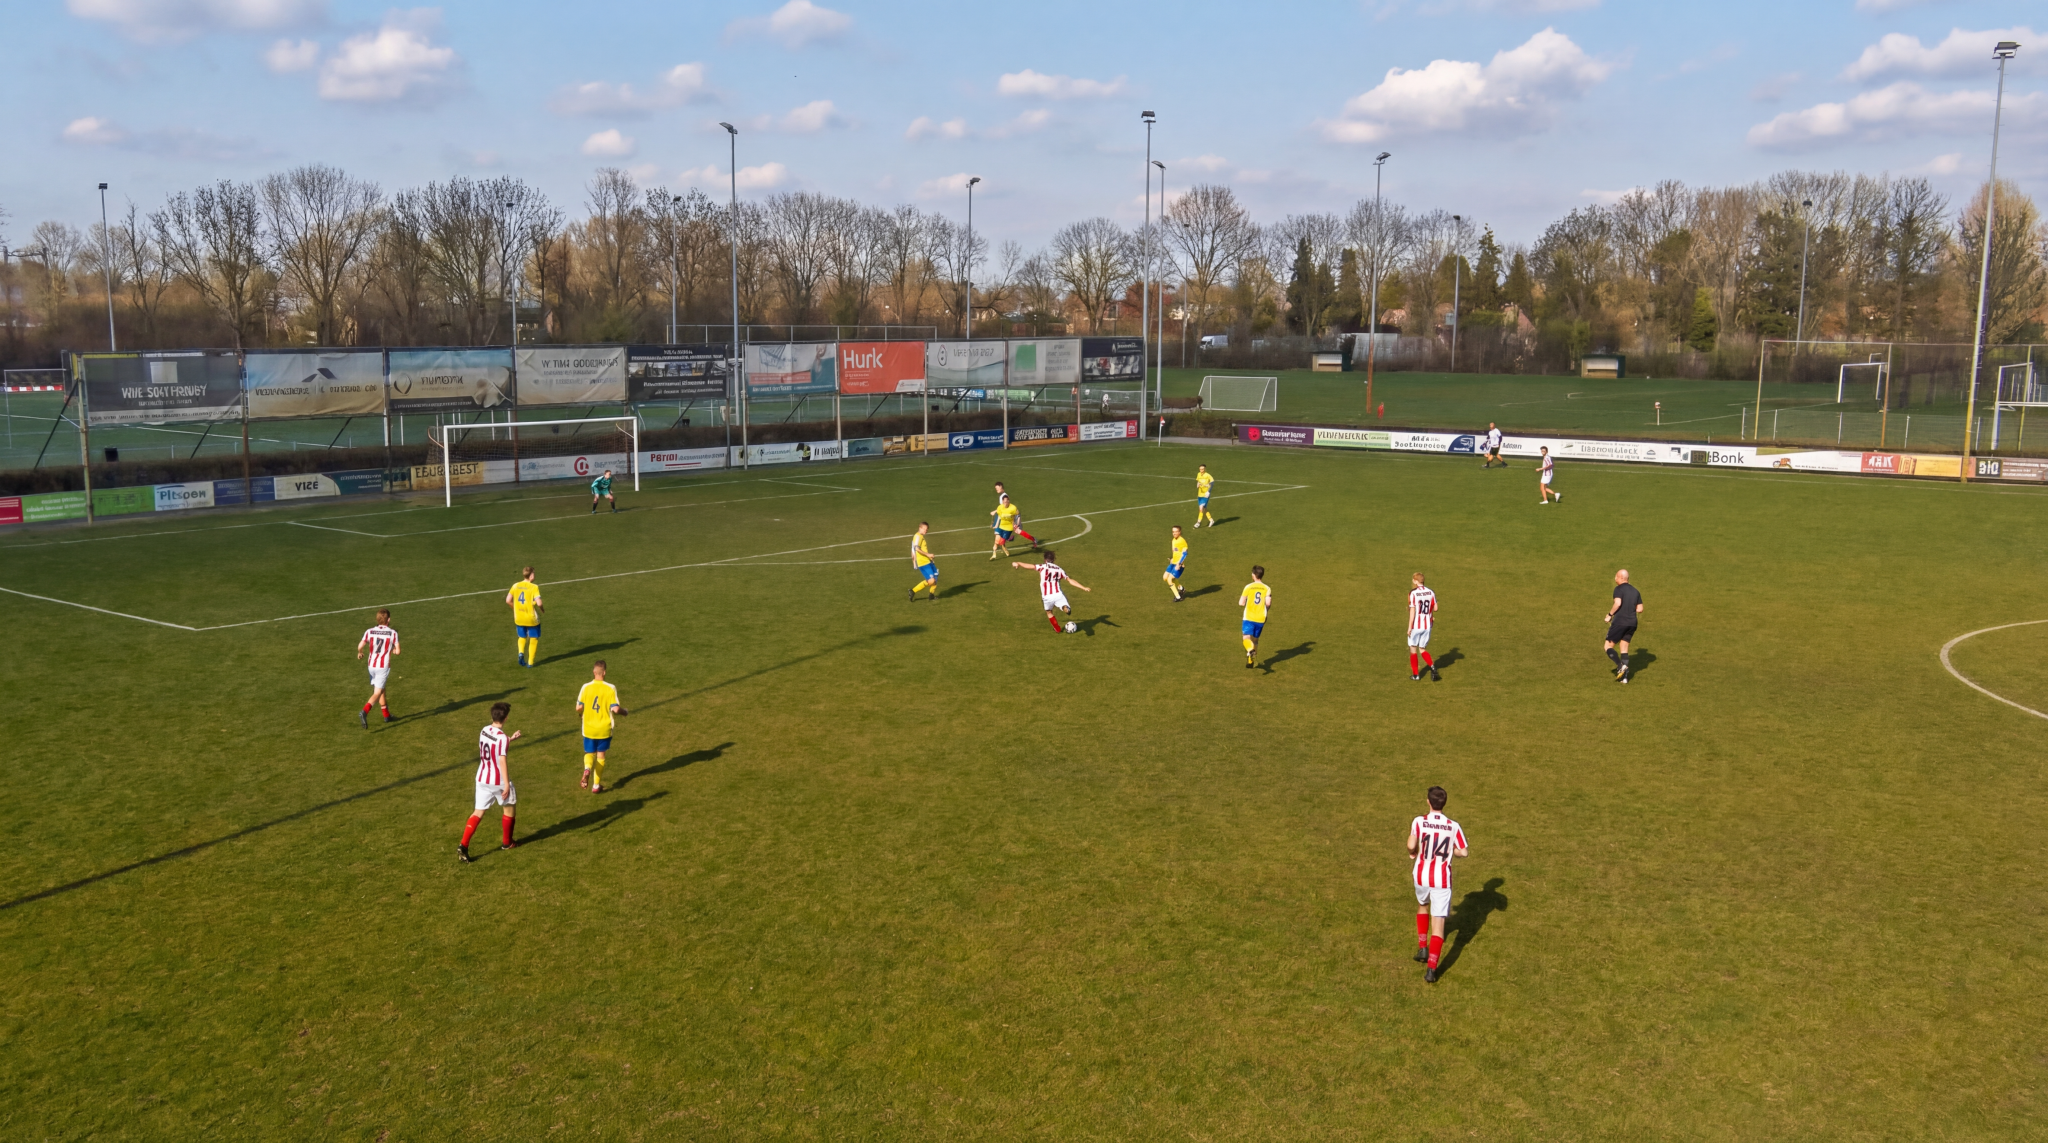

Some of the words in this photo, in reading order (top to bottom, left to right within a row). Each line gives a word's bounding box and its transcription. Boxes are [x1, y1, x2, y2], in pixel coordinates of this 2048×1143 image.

[843, 347, 883, 369] Hurk
[518, 591, 525, 604] 4
[592, 695, 600, 713] 4
[1421, 834, 1451, 862] 14
